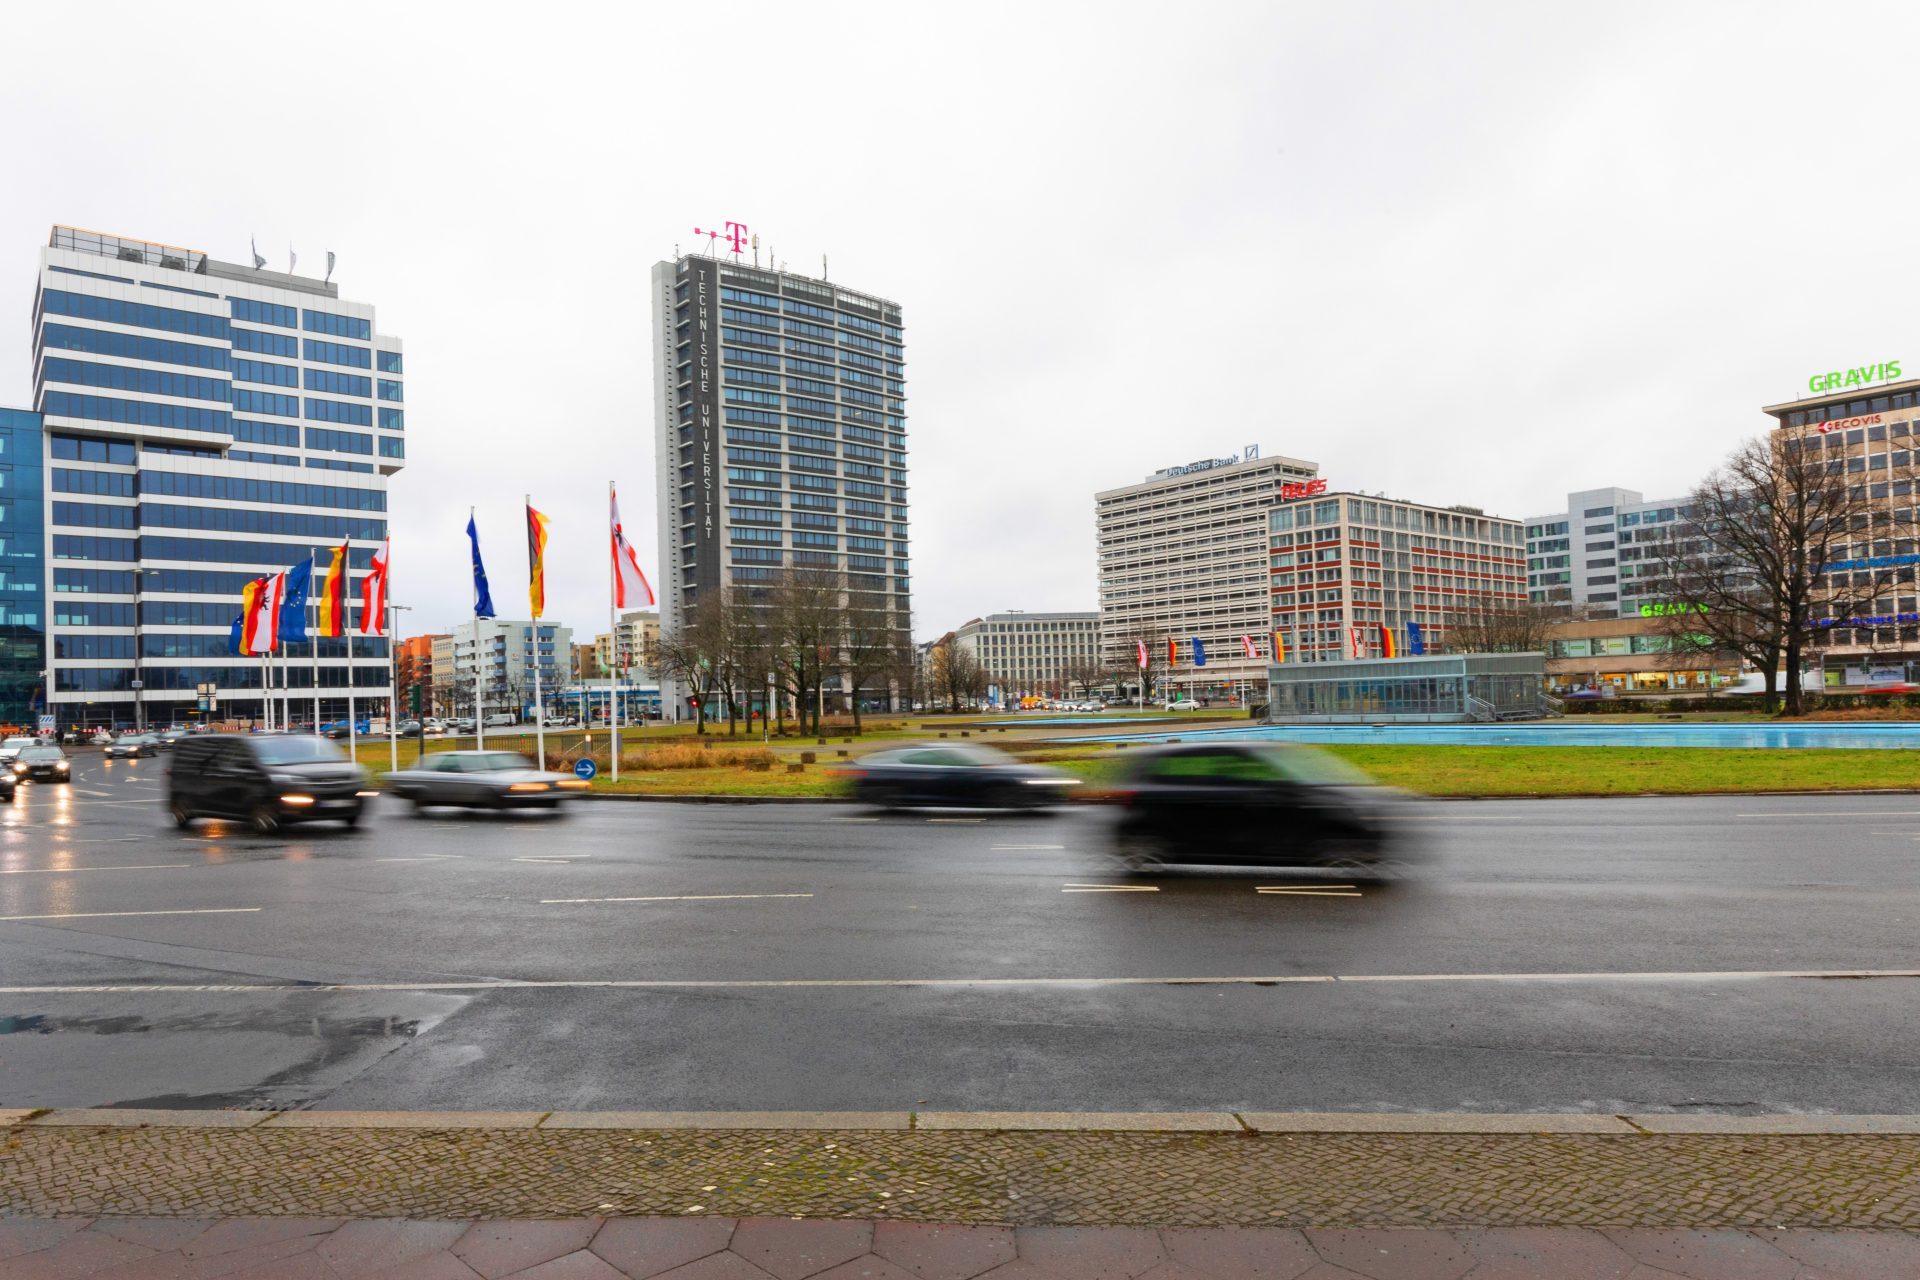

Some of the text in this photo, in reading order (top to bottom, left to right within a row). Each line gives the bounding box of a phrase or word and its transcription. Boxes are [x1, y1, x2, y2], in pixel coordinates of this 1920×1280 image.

[725, 221, 748, 254] T
[699, 270, 709, 393] TECHNISCHE
[1809, 360, 1902, 392] GRAVIS
[1834, 415, 1882, 430] ECOVIS
[1167, 453, 1240, 477] Deutsche Bank
[1641, 602, 1710, 618] GRAVS
